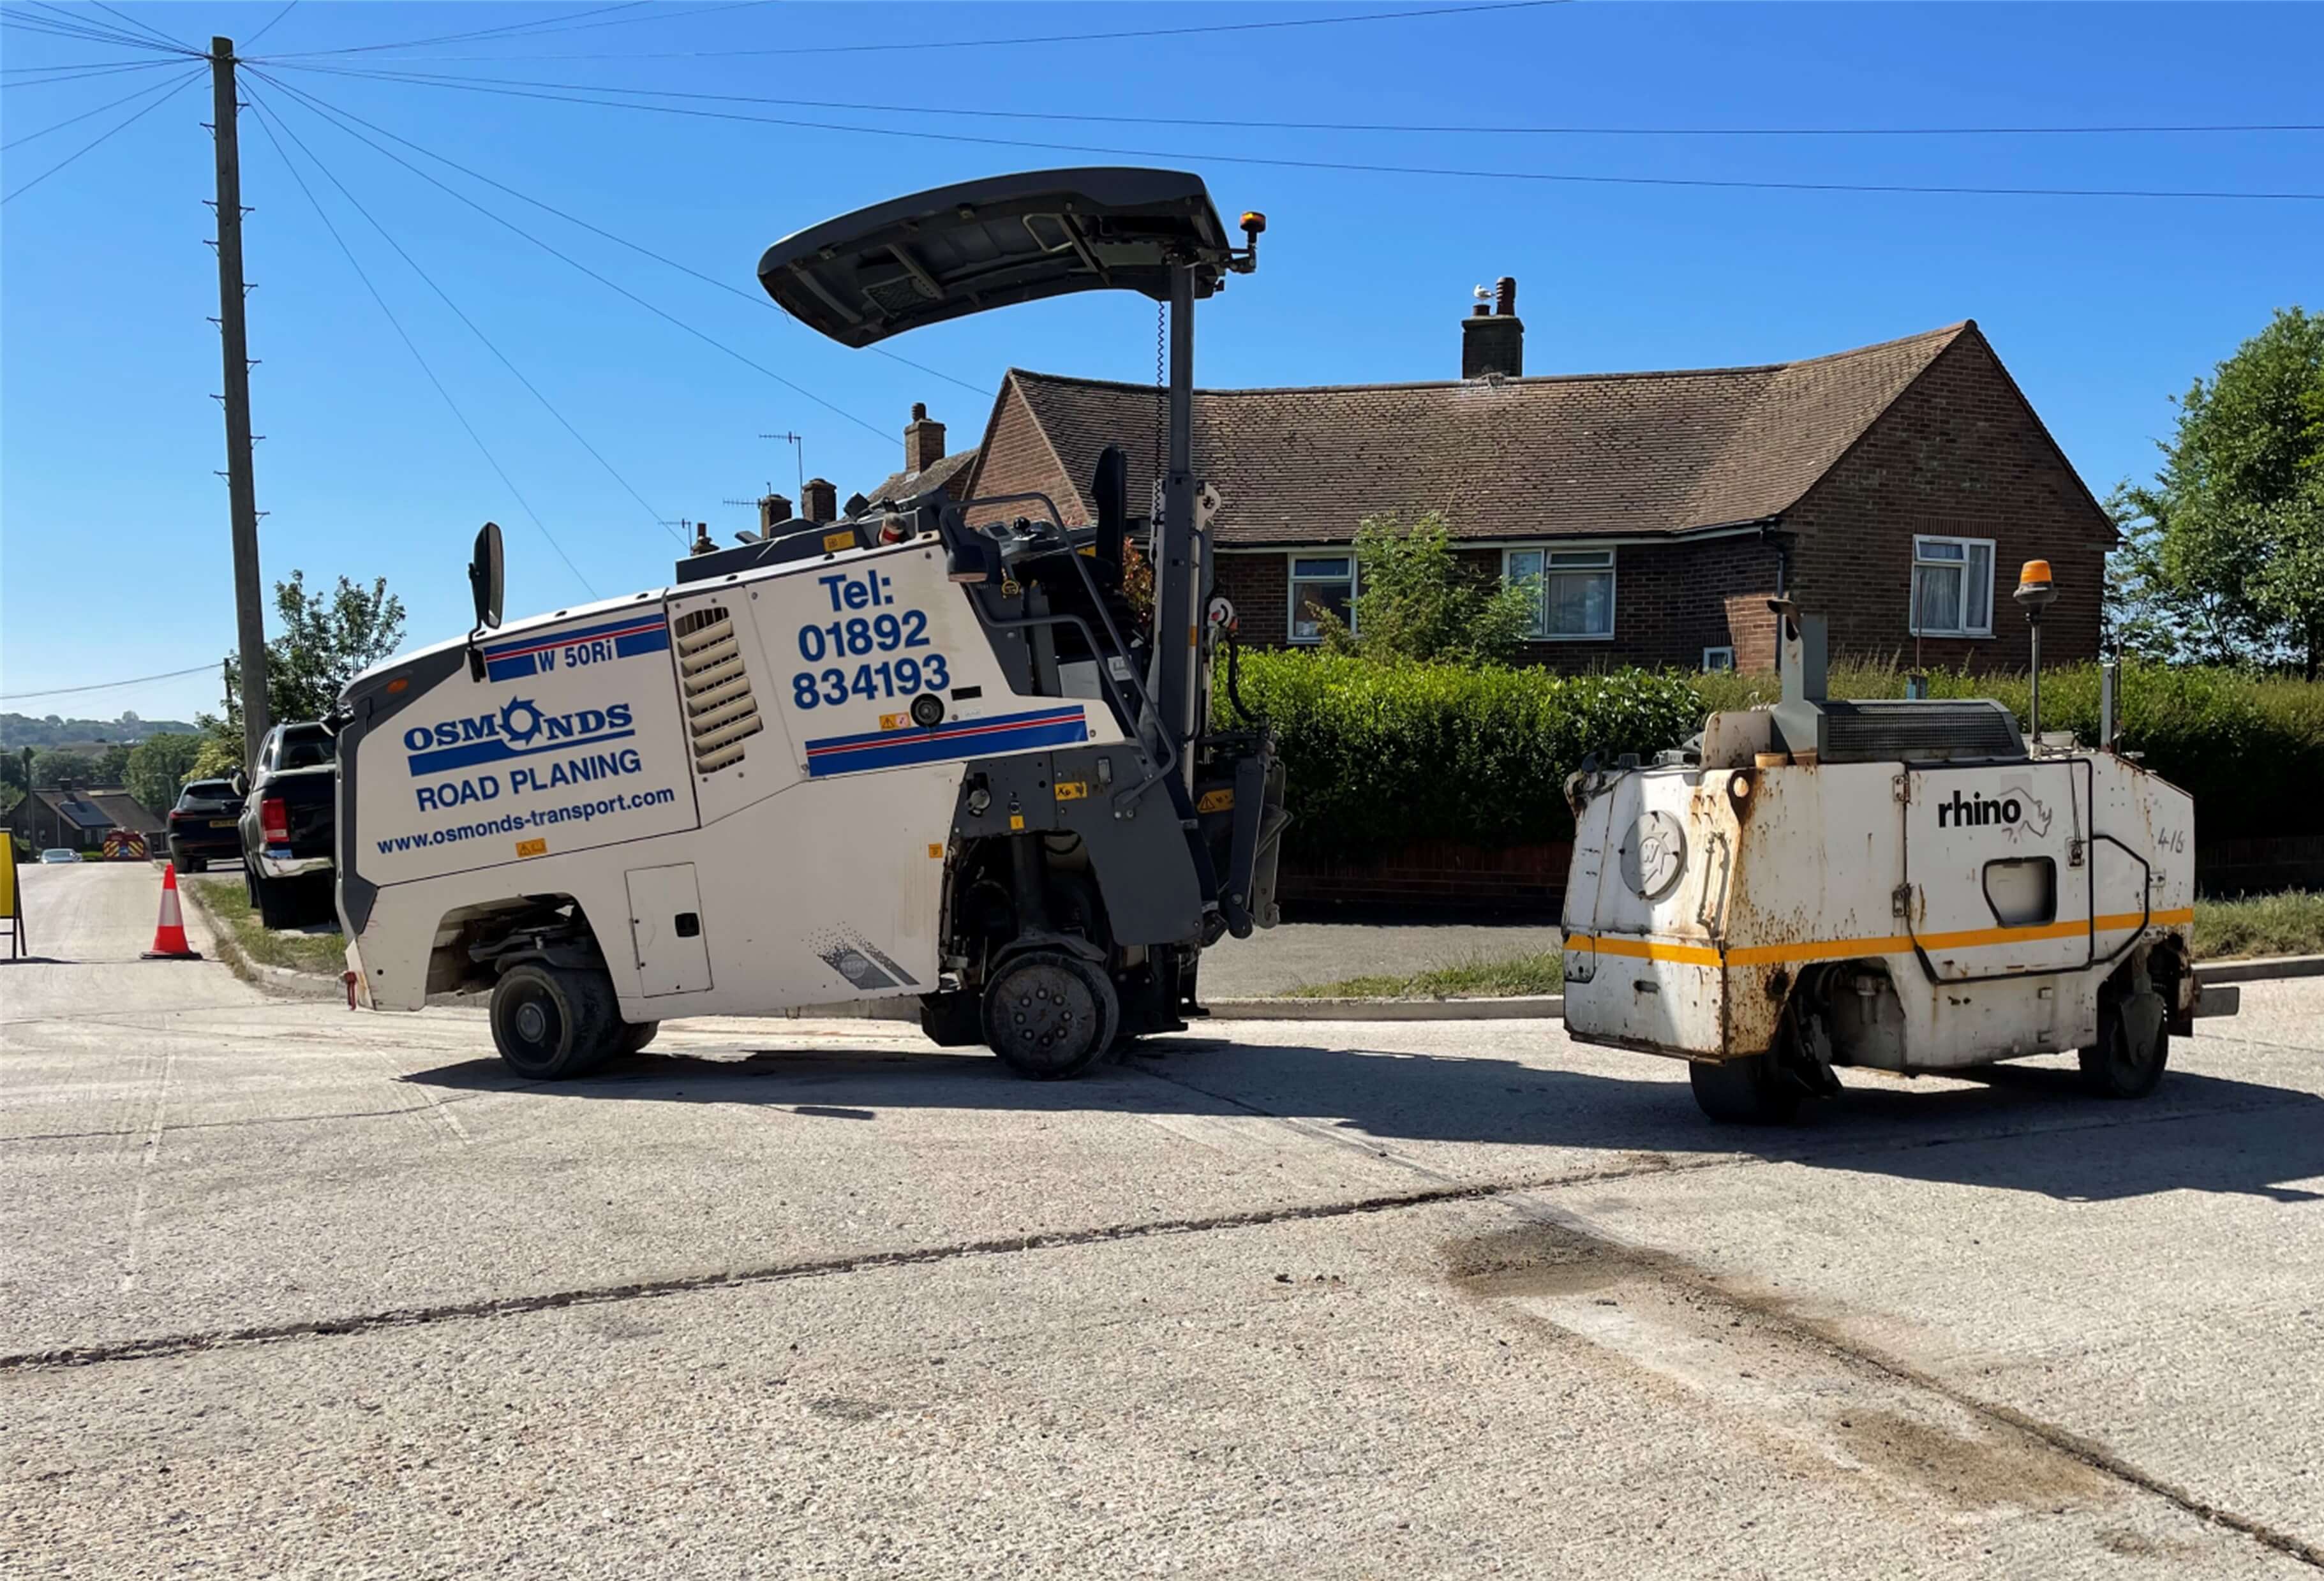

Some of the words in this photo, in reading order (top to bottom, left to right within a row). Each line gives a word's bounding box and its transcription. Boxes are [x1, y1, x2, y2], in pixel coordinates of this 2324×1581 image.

[818, 570, 894, 611] Tel:
[537, 649, 555, 671] W
[565, 639, 612, 668] 50Ri
[798, 610, 930, 662] 01892
[793, 654, 950, 709] 834193
[404, 696, 632, 751] OSMONDS
[415, 775, 500, 812] ROAD
[509, 749, 641, 795] PLANING
[377, 788, 674, 854] www.osmonds-transport.com
[1938, 790, 2022, 828] rhino
